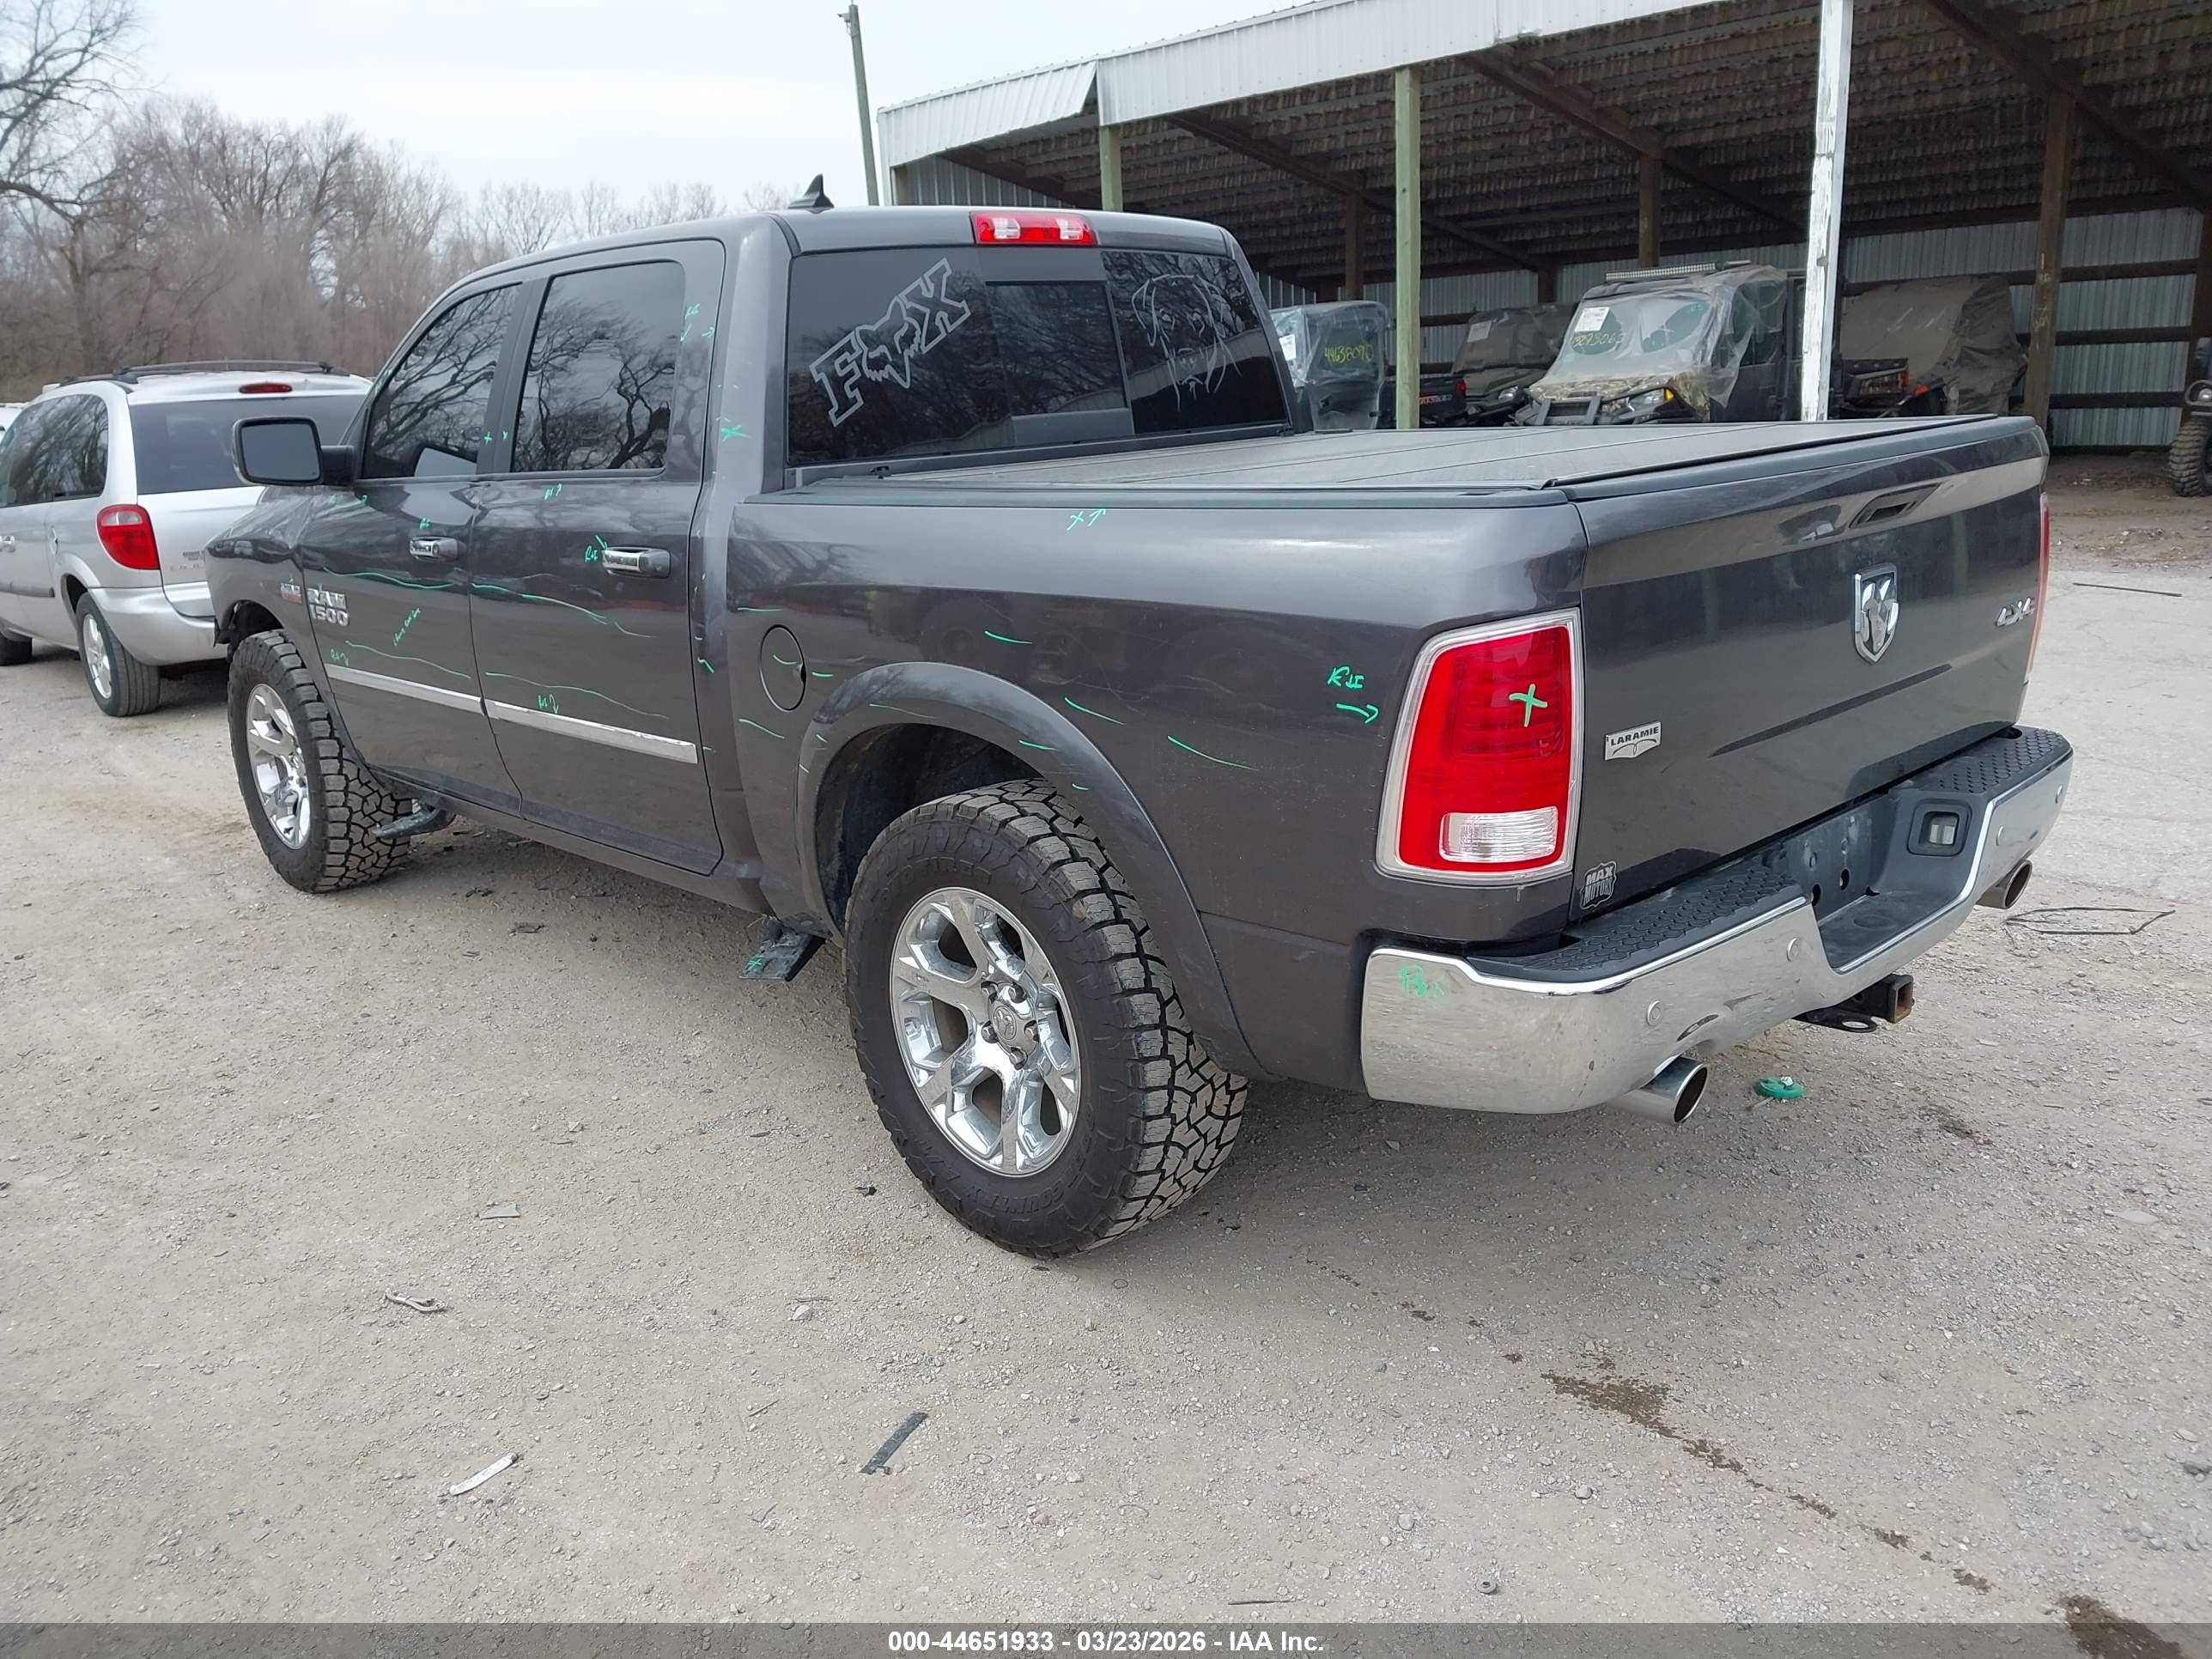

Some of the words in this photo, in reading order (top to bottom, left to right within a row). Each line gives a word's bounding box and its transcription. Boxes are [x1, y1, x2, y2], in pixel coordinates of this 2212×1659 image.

[307, 587, 347, 610] RAM
[310, 604, 349, 626] 1500
[1611, 726, 1659, 746] LARAMIE
[1585, 865, 1614, 886] MAX
[1583, 876, 1613, 908] MOTORS
